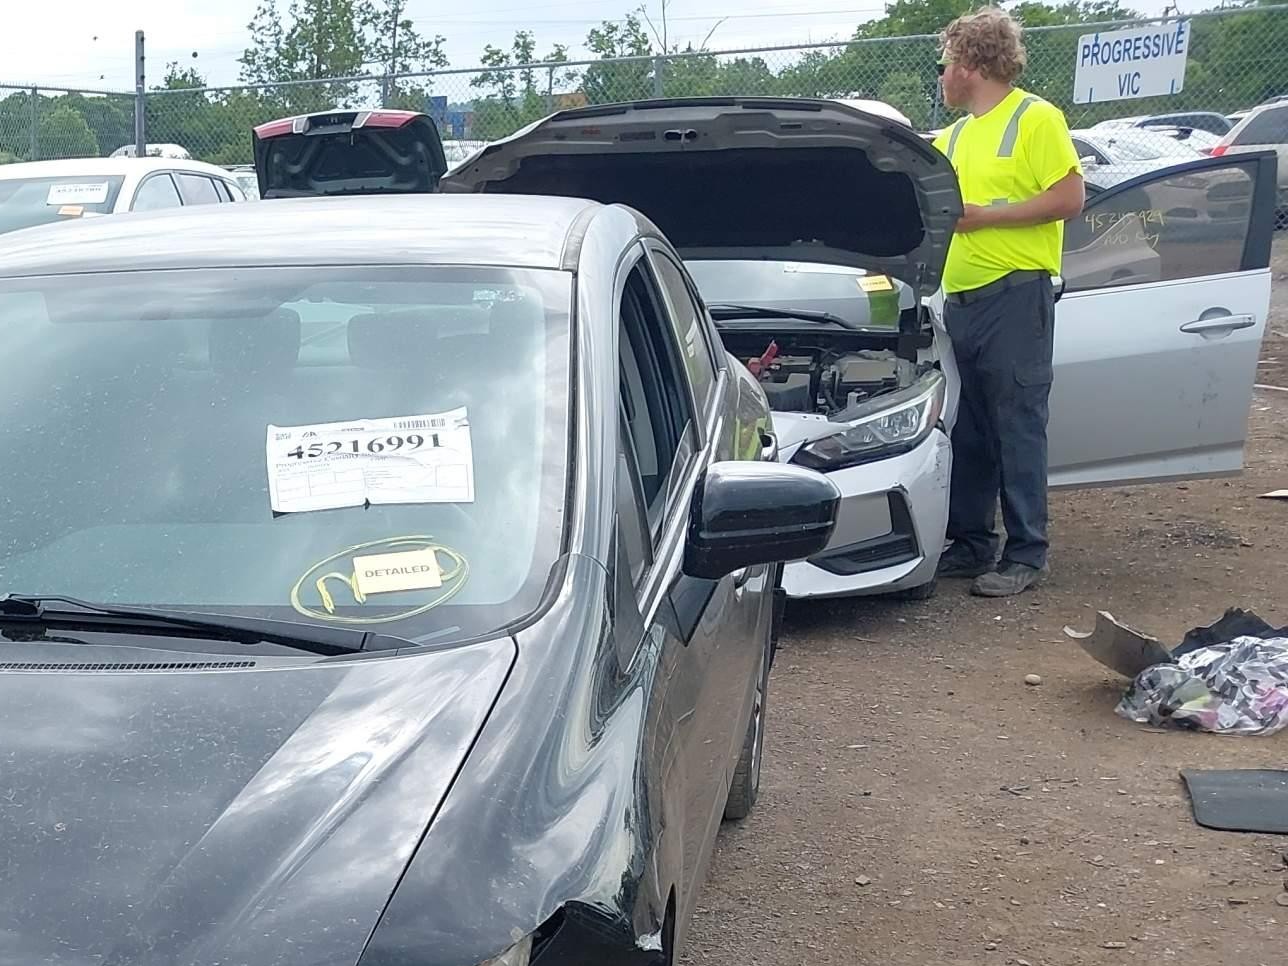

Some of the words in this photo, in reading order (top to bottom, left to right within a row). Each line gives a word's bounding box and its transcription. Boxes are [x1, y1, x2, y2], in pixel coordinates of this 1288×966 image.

[1081, 31, 1185, 68] PROGRESSIVE
[1118, 71, 1141, 96] VIC
[287, 433, 445, 460] 45216991
[364, 564, 431, 579] DETAILED
